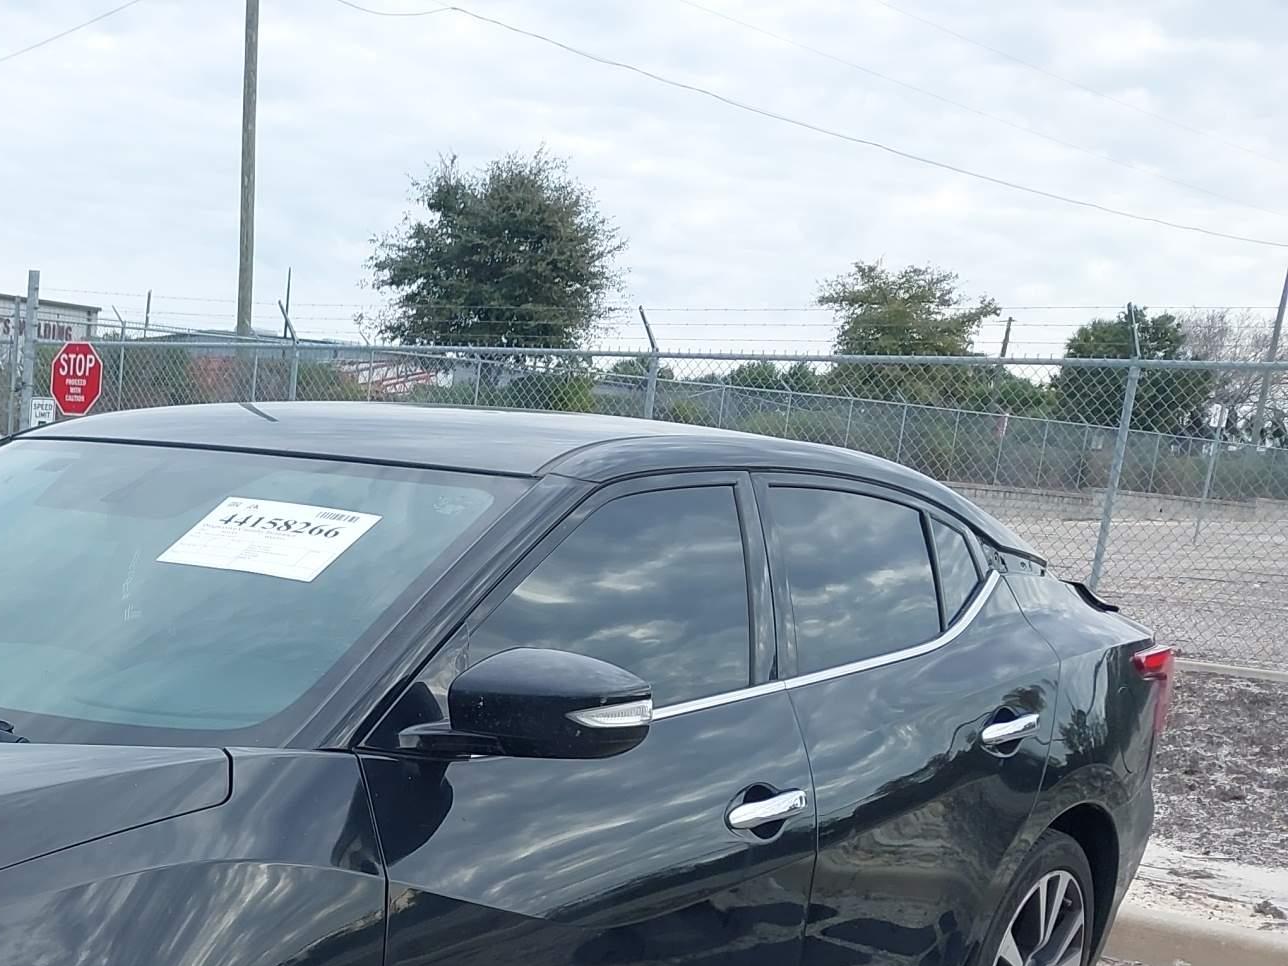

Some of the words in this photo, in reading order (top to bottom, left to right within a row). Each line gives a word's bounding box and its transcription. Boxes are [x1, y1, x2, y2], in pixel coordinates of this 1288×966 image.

[18, 317, 73, 341] WLDING
[59, 353, 96, 376] STOP
[33, 403, 53, 411] SPEED
[218, 513, 346, 539] 44158266
